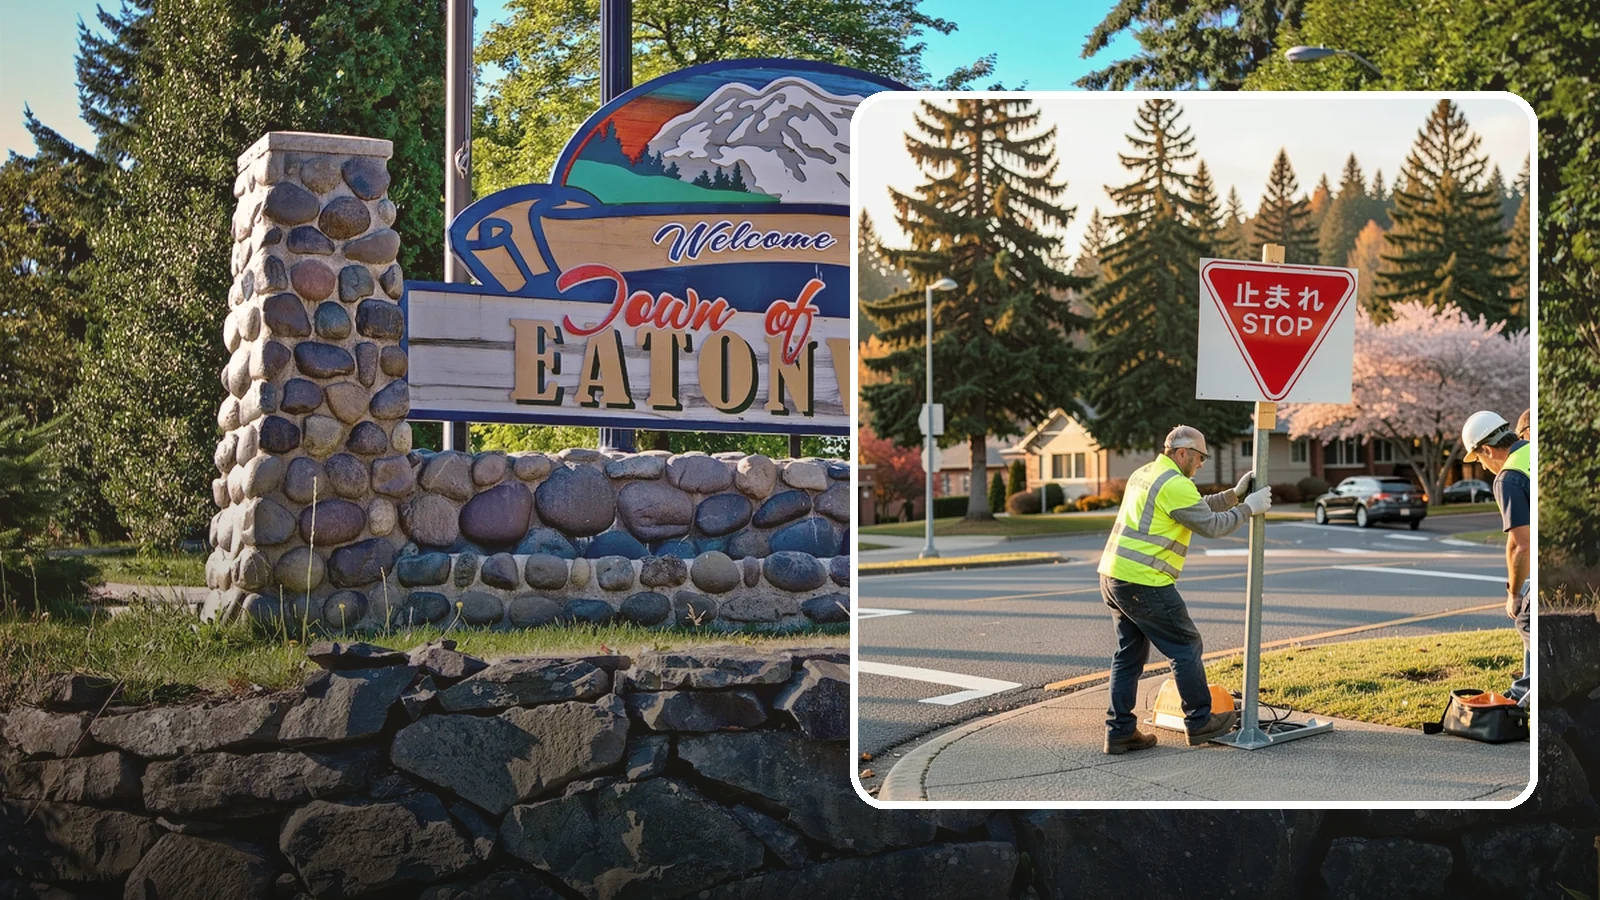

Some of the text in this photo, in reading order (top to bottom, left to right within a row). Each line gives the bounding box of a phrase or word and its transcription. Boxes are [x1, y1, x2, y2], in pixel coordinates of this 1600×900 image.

[654, 221, 837, 263] Welcome
[557, 264, 826, 365] Town of
[1233, 281, 1324, 312] 止まれ
[1242, 312, 1313, 337] STOP
